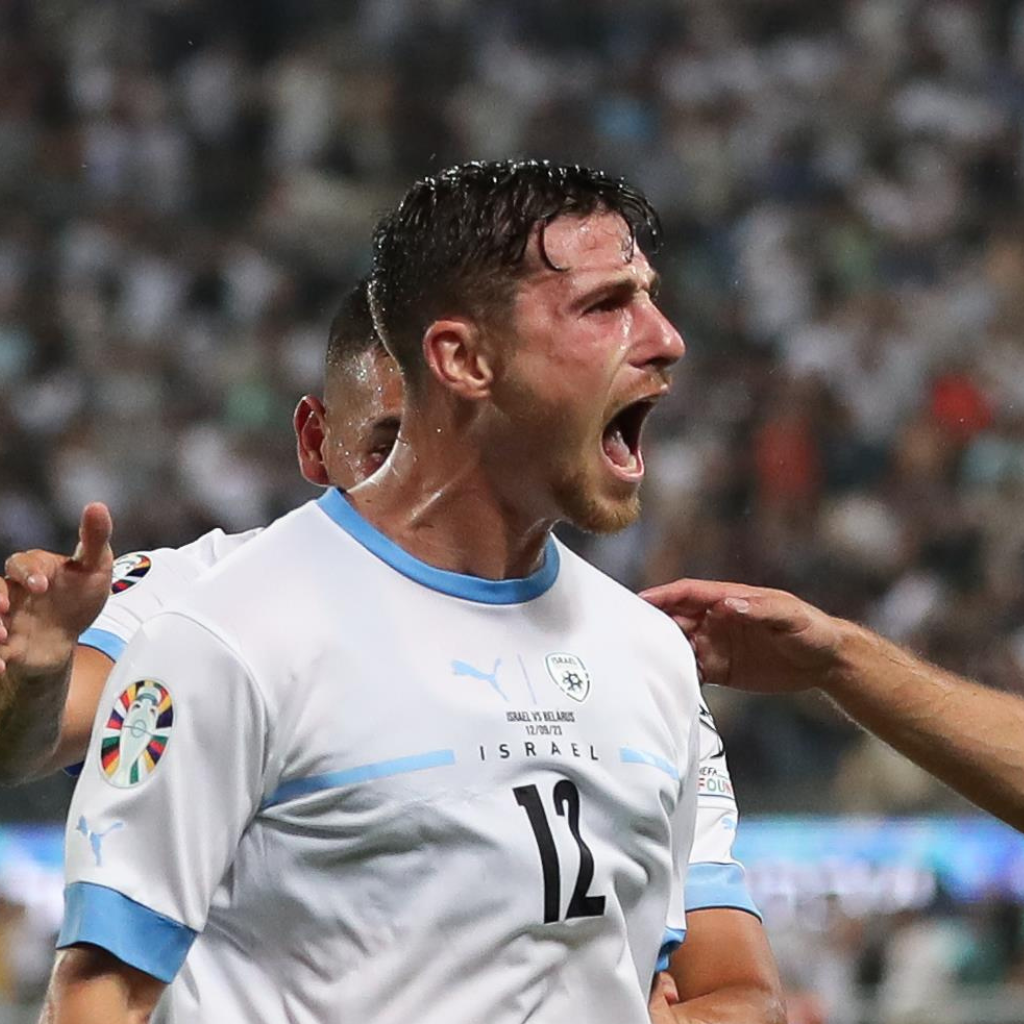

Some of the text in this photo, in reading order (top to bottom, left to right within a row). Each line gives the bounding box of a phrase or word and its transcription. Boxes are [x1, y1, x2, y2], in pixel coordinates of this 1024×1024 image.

[506, 711, 575, 722] ISRAEL VS BELARUS
[526, 725, 562, 736] 12/09/23
[480, 741, 599, 761] ISRAEL
[512, 779, 606, 924] 12
